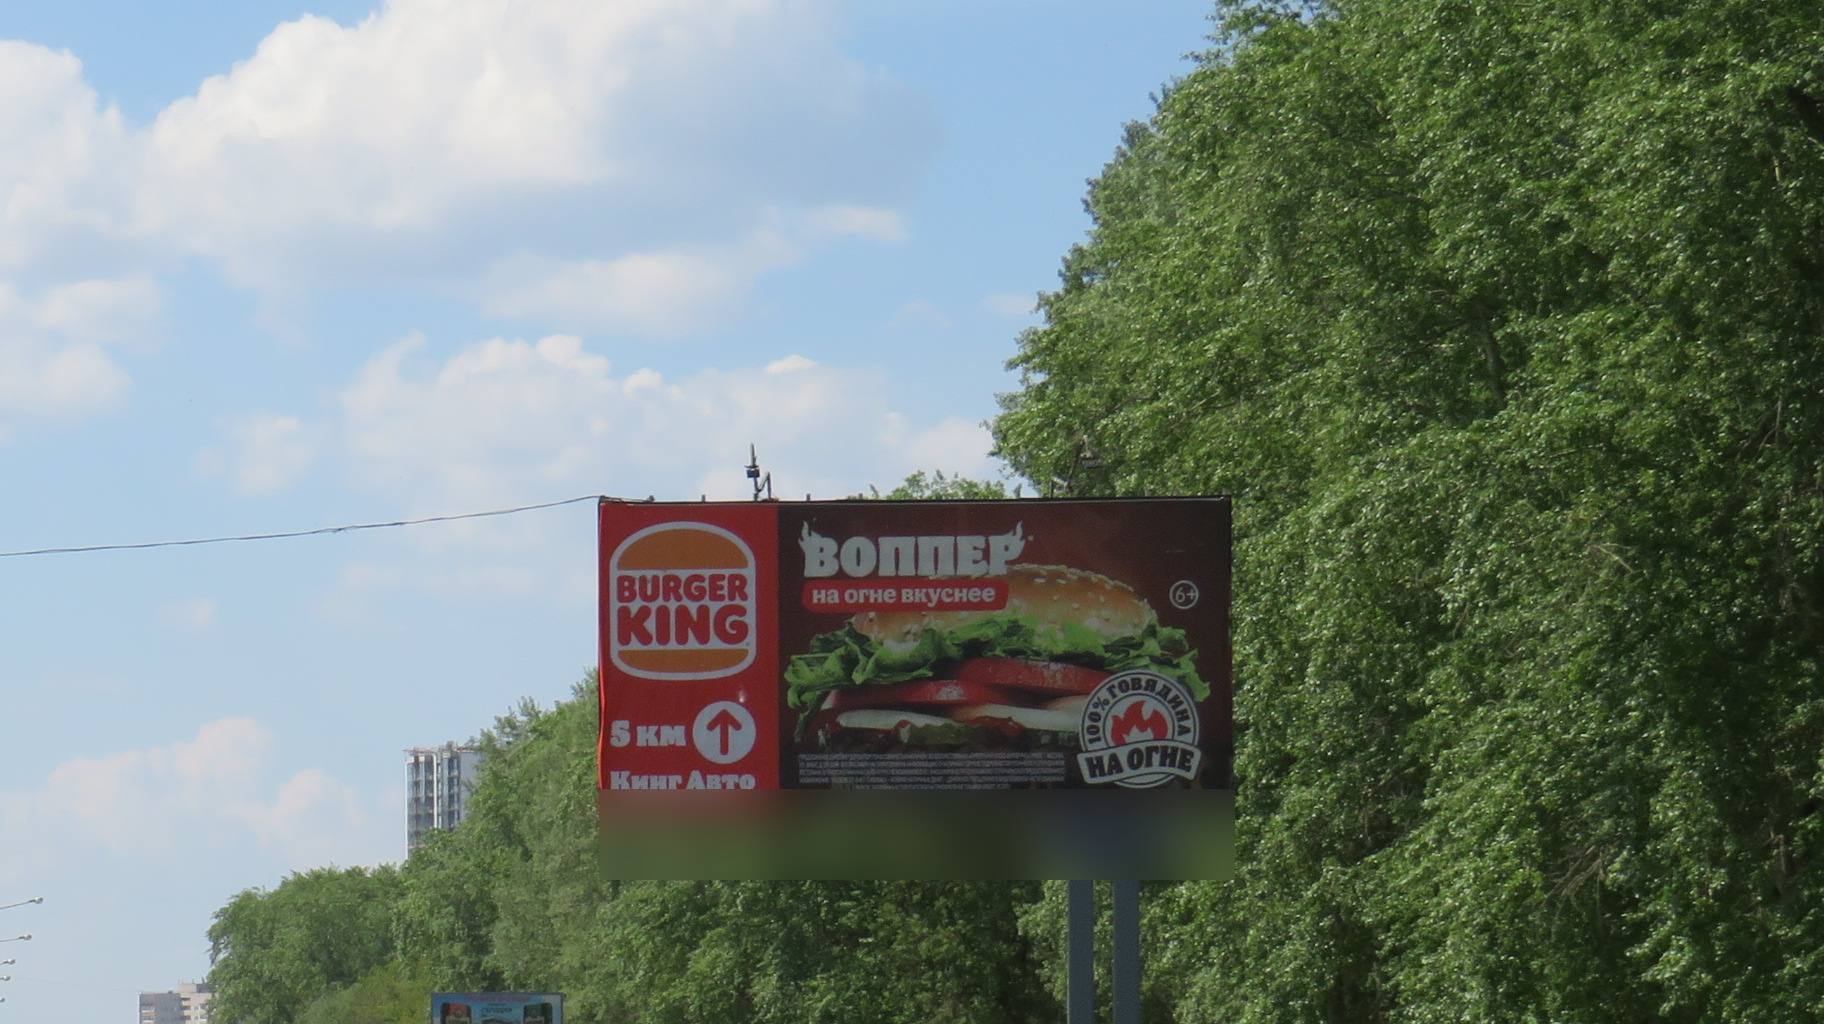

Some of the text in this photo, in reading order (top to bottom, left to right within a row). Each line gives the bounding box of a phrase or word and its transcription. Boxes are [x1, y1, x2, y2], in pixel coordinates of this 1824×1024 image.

[799, 520, 1025, 577] ВОППЕР
[616, 574, 749, 603] BURGER
[813, 587, 996, 607] на огне вкуснее
[1175, 586, 1197, 603] 6+
[616, 604, 749, 646] KING
[1107, 676, 1192, 737] ГОВЯДИНА
[610, 720, 630, 748] 5
[1085, 752, 1124, 779] НА
[1127, 746, 1195, 773] ОГНЕ
[610, 770, 756, 790] Кинг Авто
